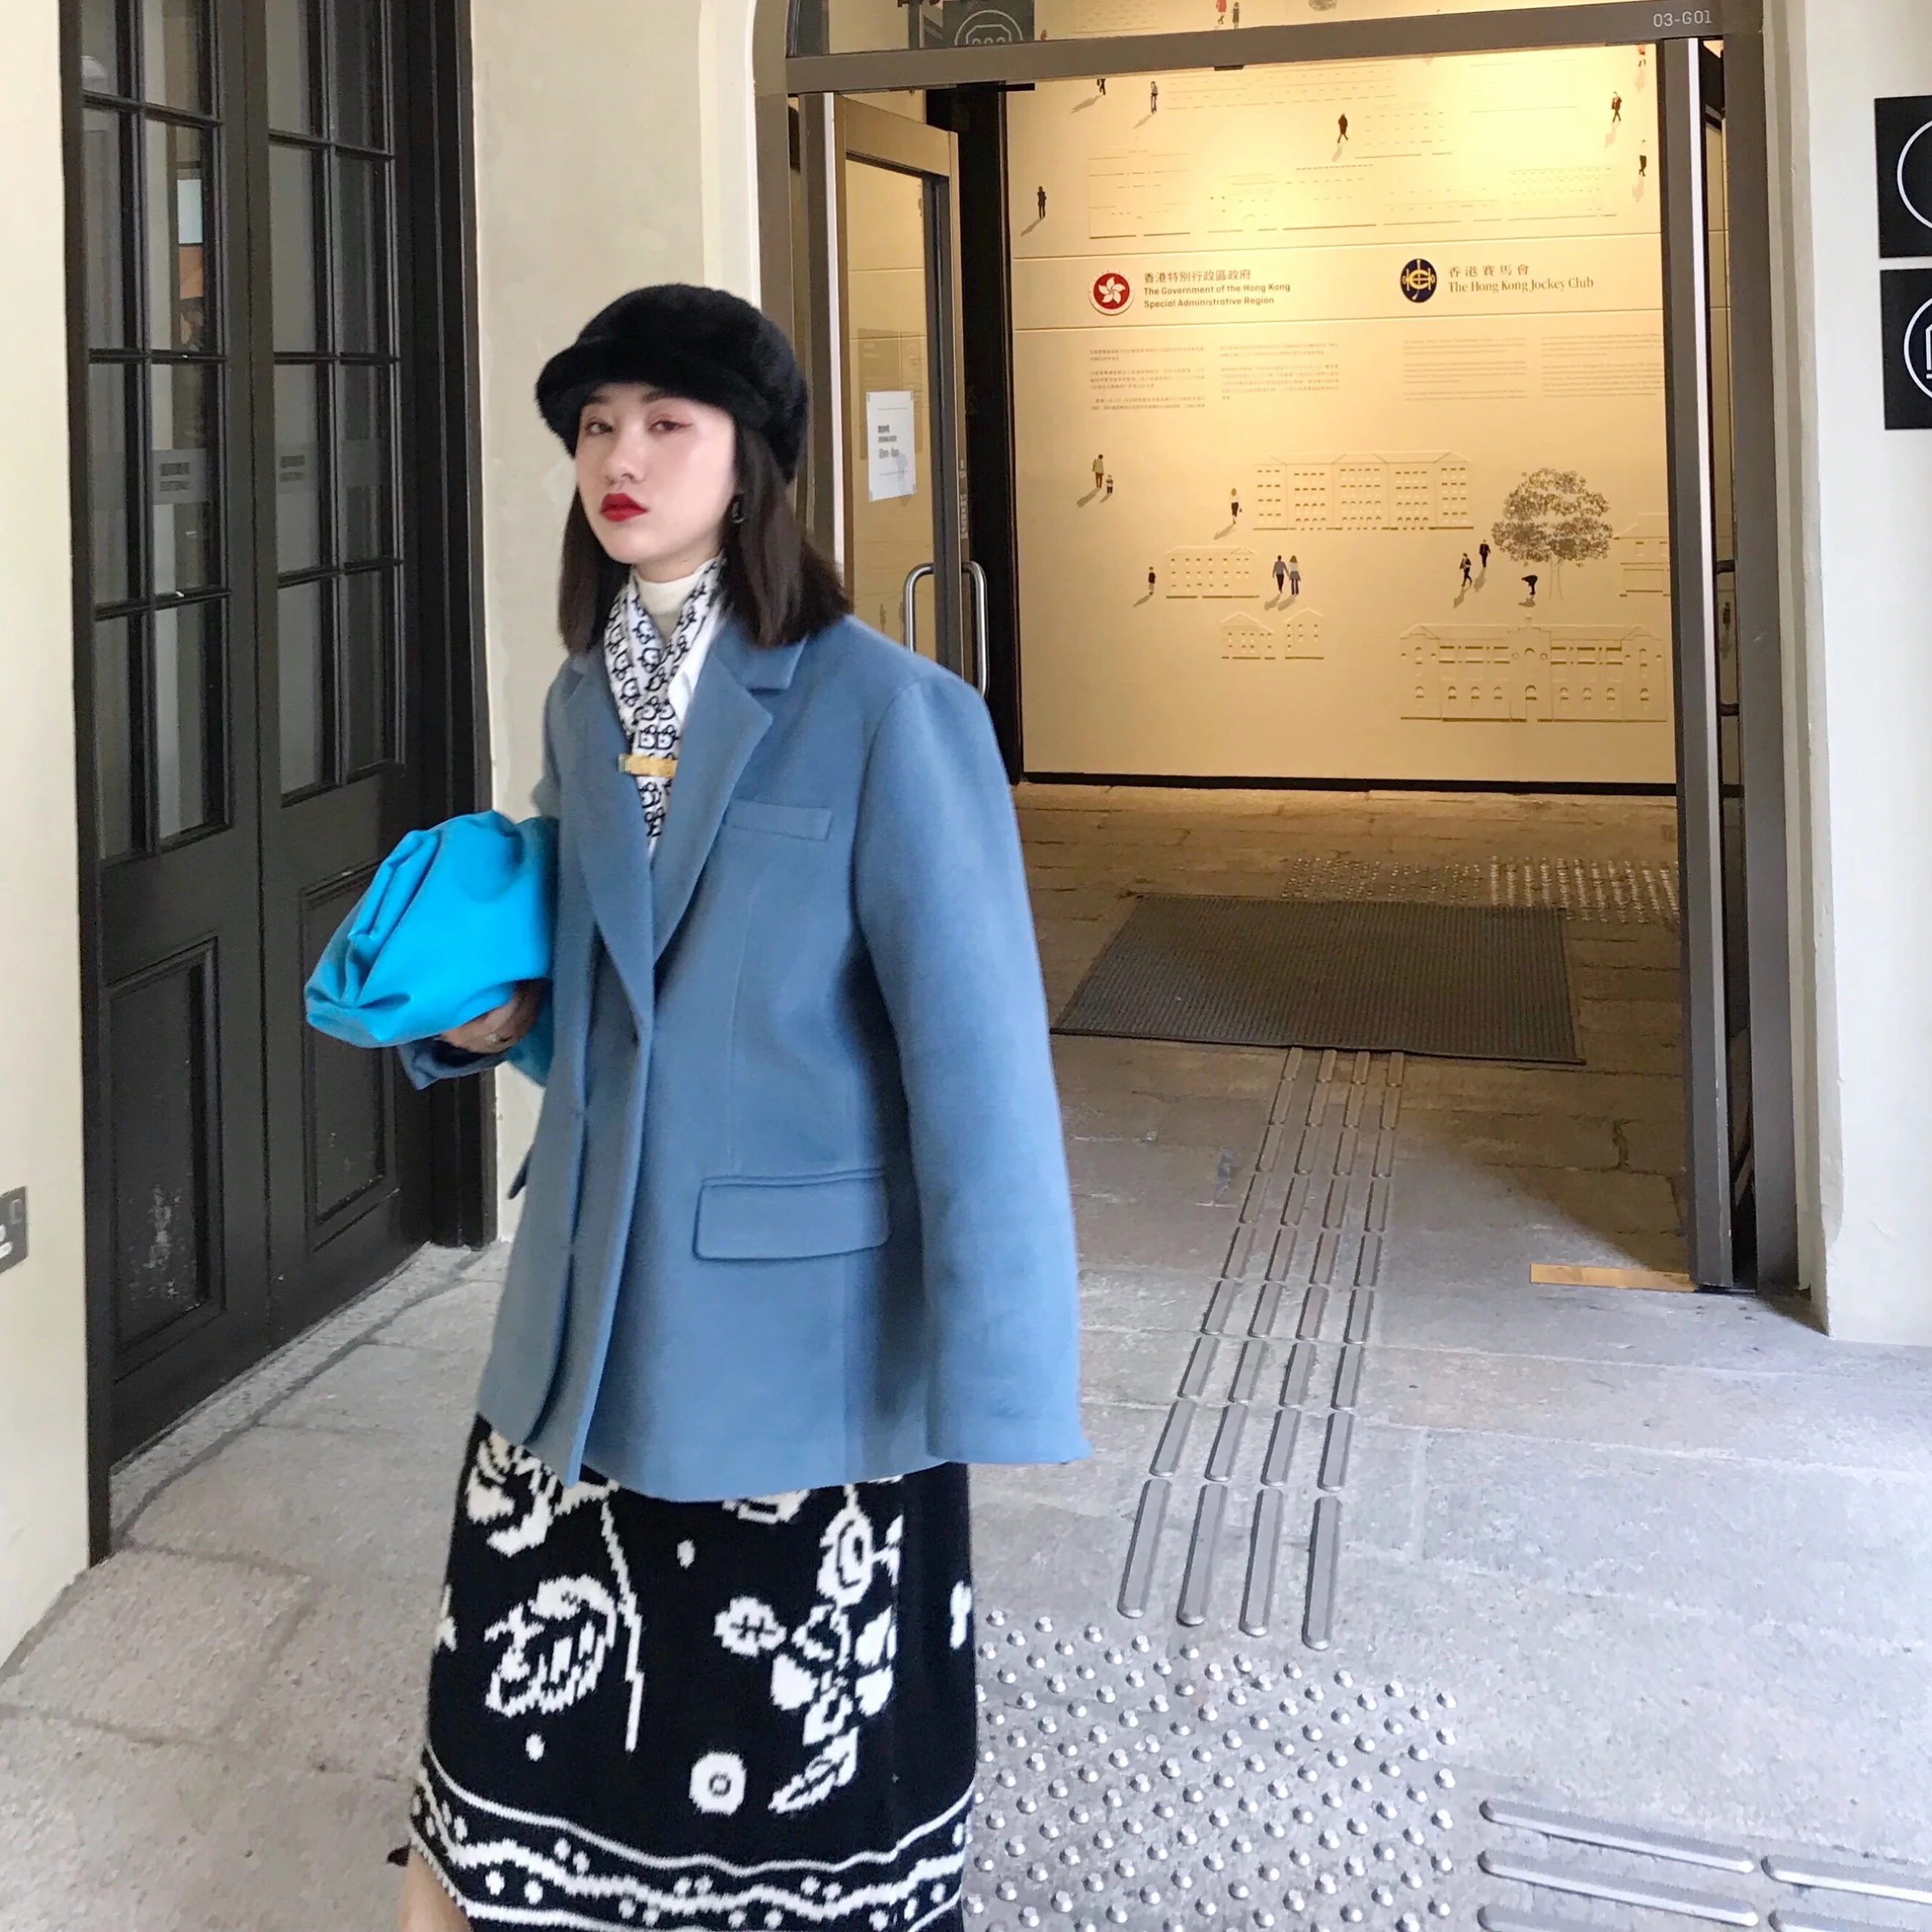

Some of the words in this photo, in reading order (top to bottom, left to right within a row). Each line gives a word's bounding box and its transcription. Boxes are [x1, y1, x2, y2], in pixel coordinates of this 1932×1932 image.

[1653, 10, 1712, 27] 03-G01
[1144, 269, 1251, 283] 香港特別行政區政府
[1144, 286, 1159, 295] The
[1162, 285, 1213, 294] Government
[1216, 284, 1225, 293] of
[1227, 283, 1239, 293] the
[1243, 283, 1266, 294] Hong
[1268, 283, 1290, 292] Kong
[1448, 281, 1468, 293] The
[1471, 280, 1499, 293] Hong
[1501, 279, 1528, 292] Kong
[1530, 279, 1565, 291] Jockey
[1568, 277, 1594, 289] Club
[1144, 299, 1175, 308] Special
[1178, 297, 1242, 308] Administrative
[1244, 297, 1274, 305] Region
